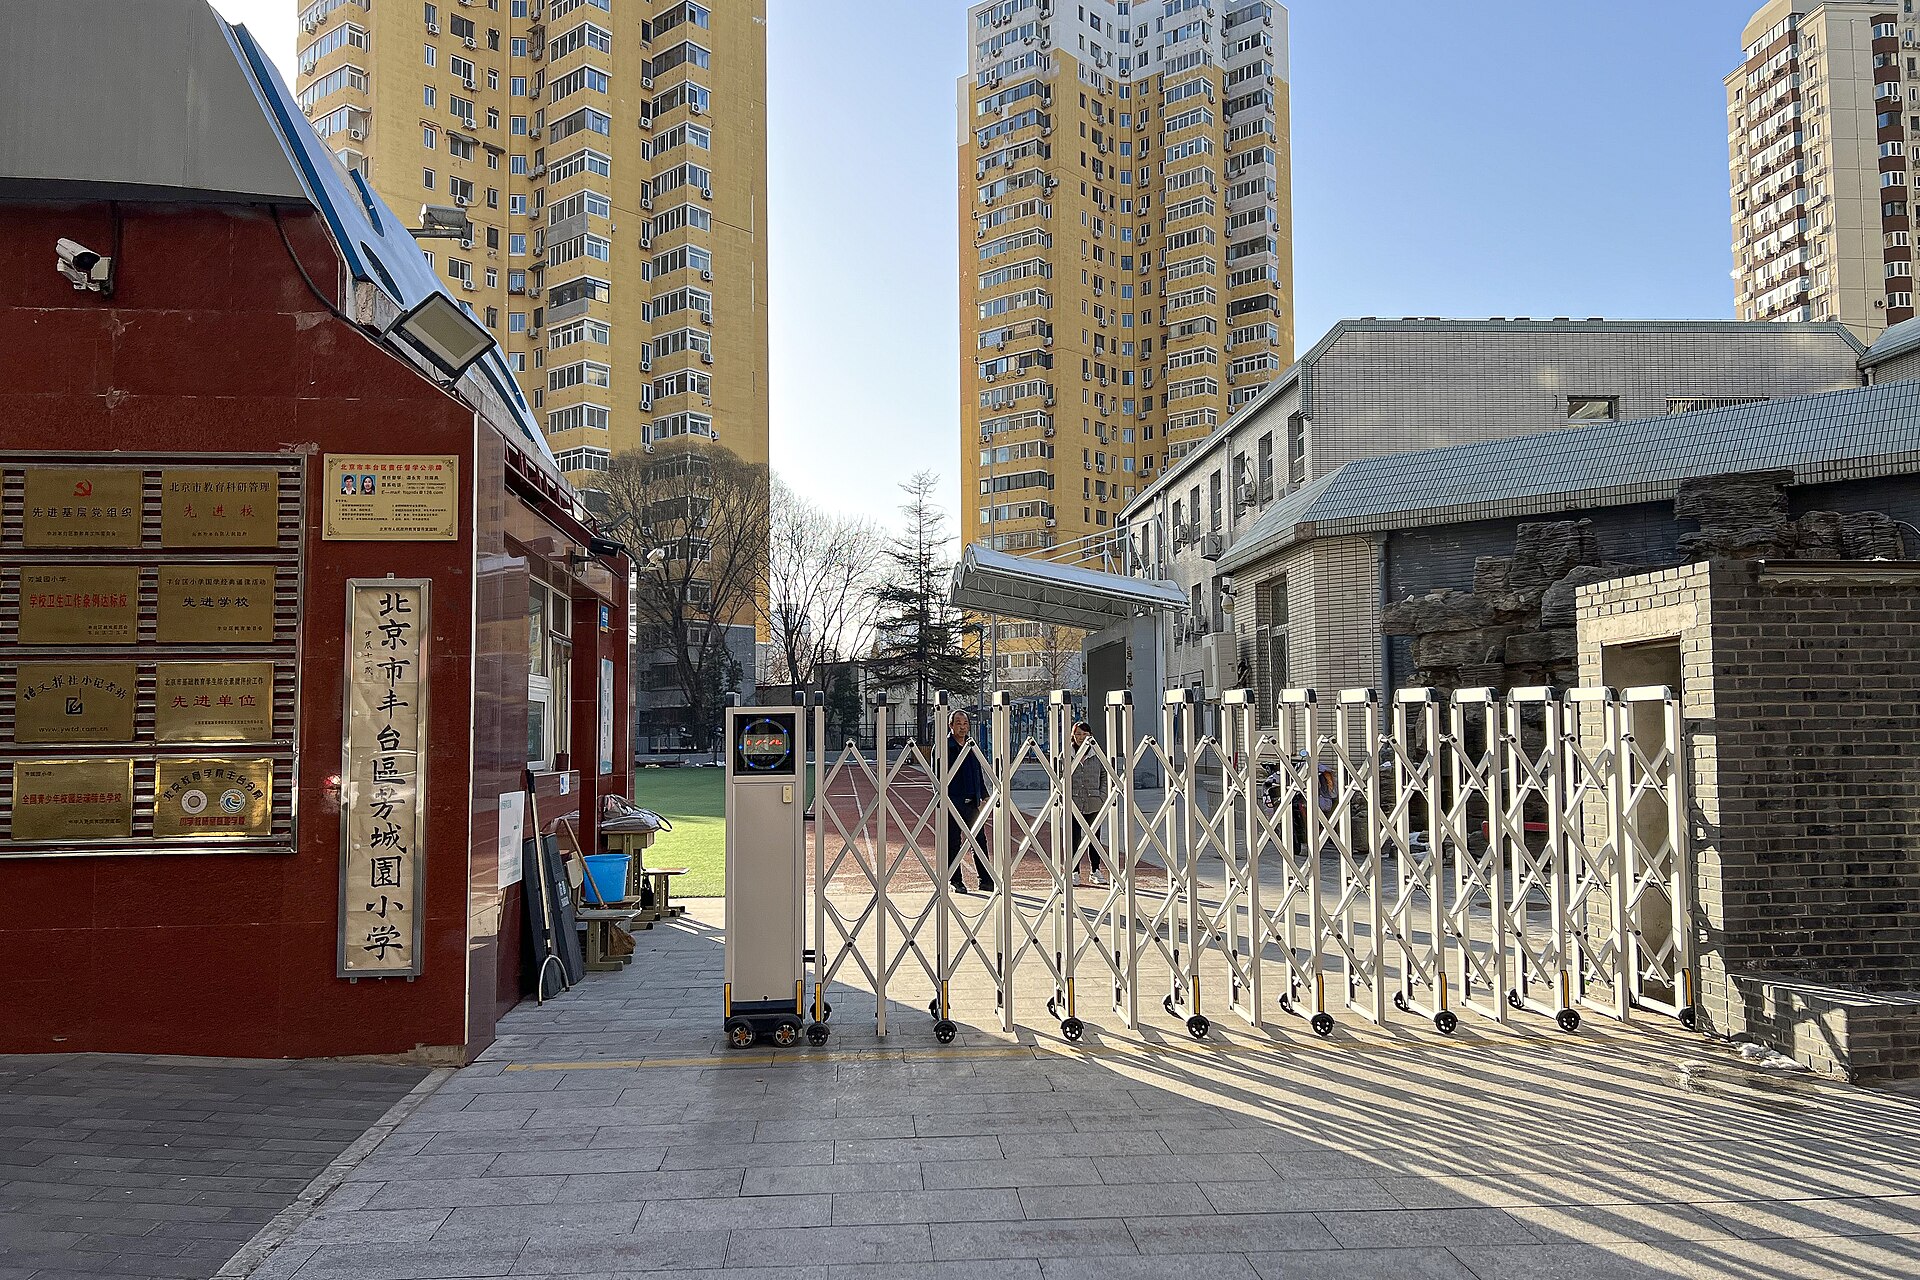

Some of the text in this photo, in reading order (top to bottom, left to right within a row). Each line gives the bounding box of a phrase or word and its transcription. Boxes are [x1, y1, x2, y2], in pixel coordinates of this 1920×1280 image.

[340, 463, 443, 471] 北京市丰台区责任督学公示牌
[169, 482, 271, 493] 北京市教育科研管理
[32, 507, 133, 518] 先进基层党组织
[183, 503, 256, 518] 先进校
[29, 593, 128, 609] 学校卫生工作条例达标校
[182, 596, 250, 608] 先进学校
[23, 675, 128, 701] 语文报社小记者站
[171, 694, 256, 708] 先进单位
[21, 792, 123, 805] 全国青少年校园足球特色学校
